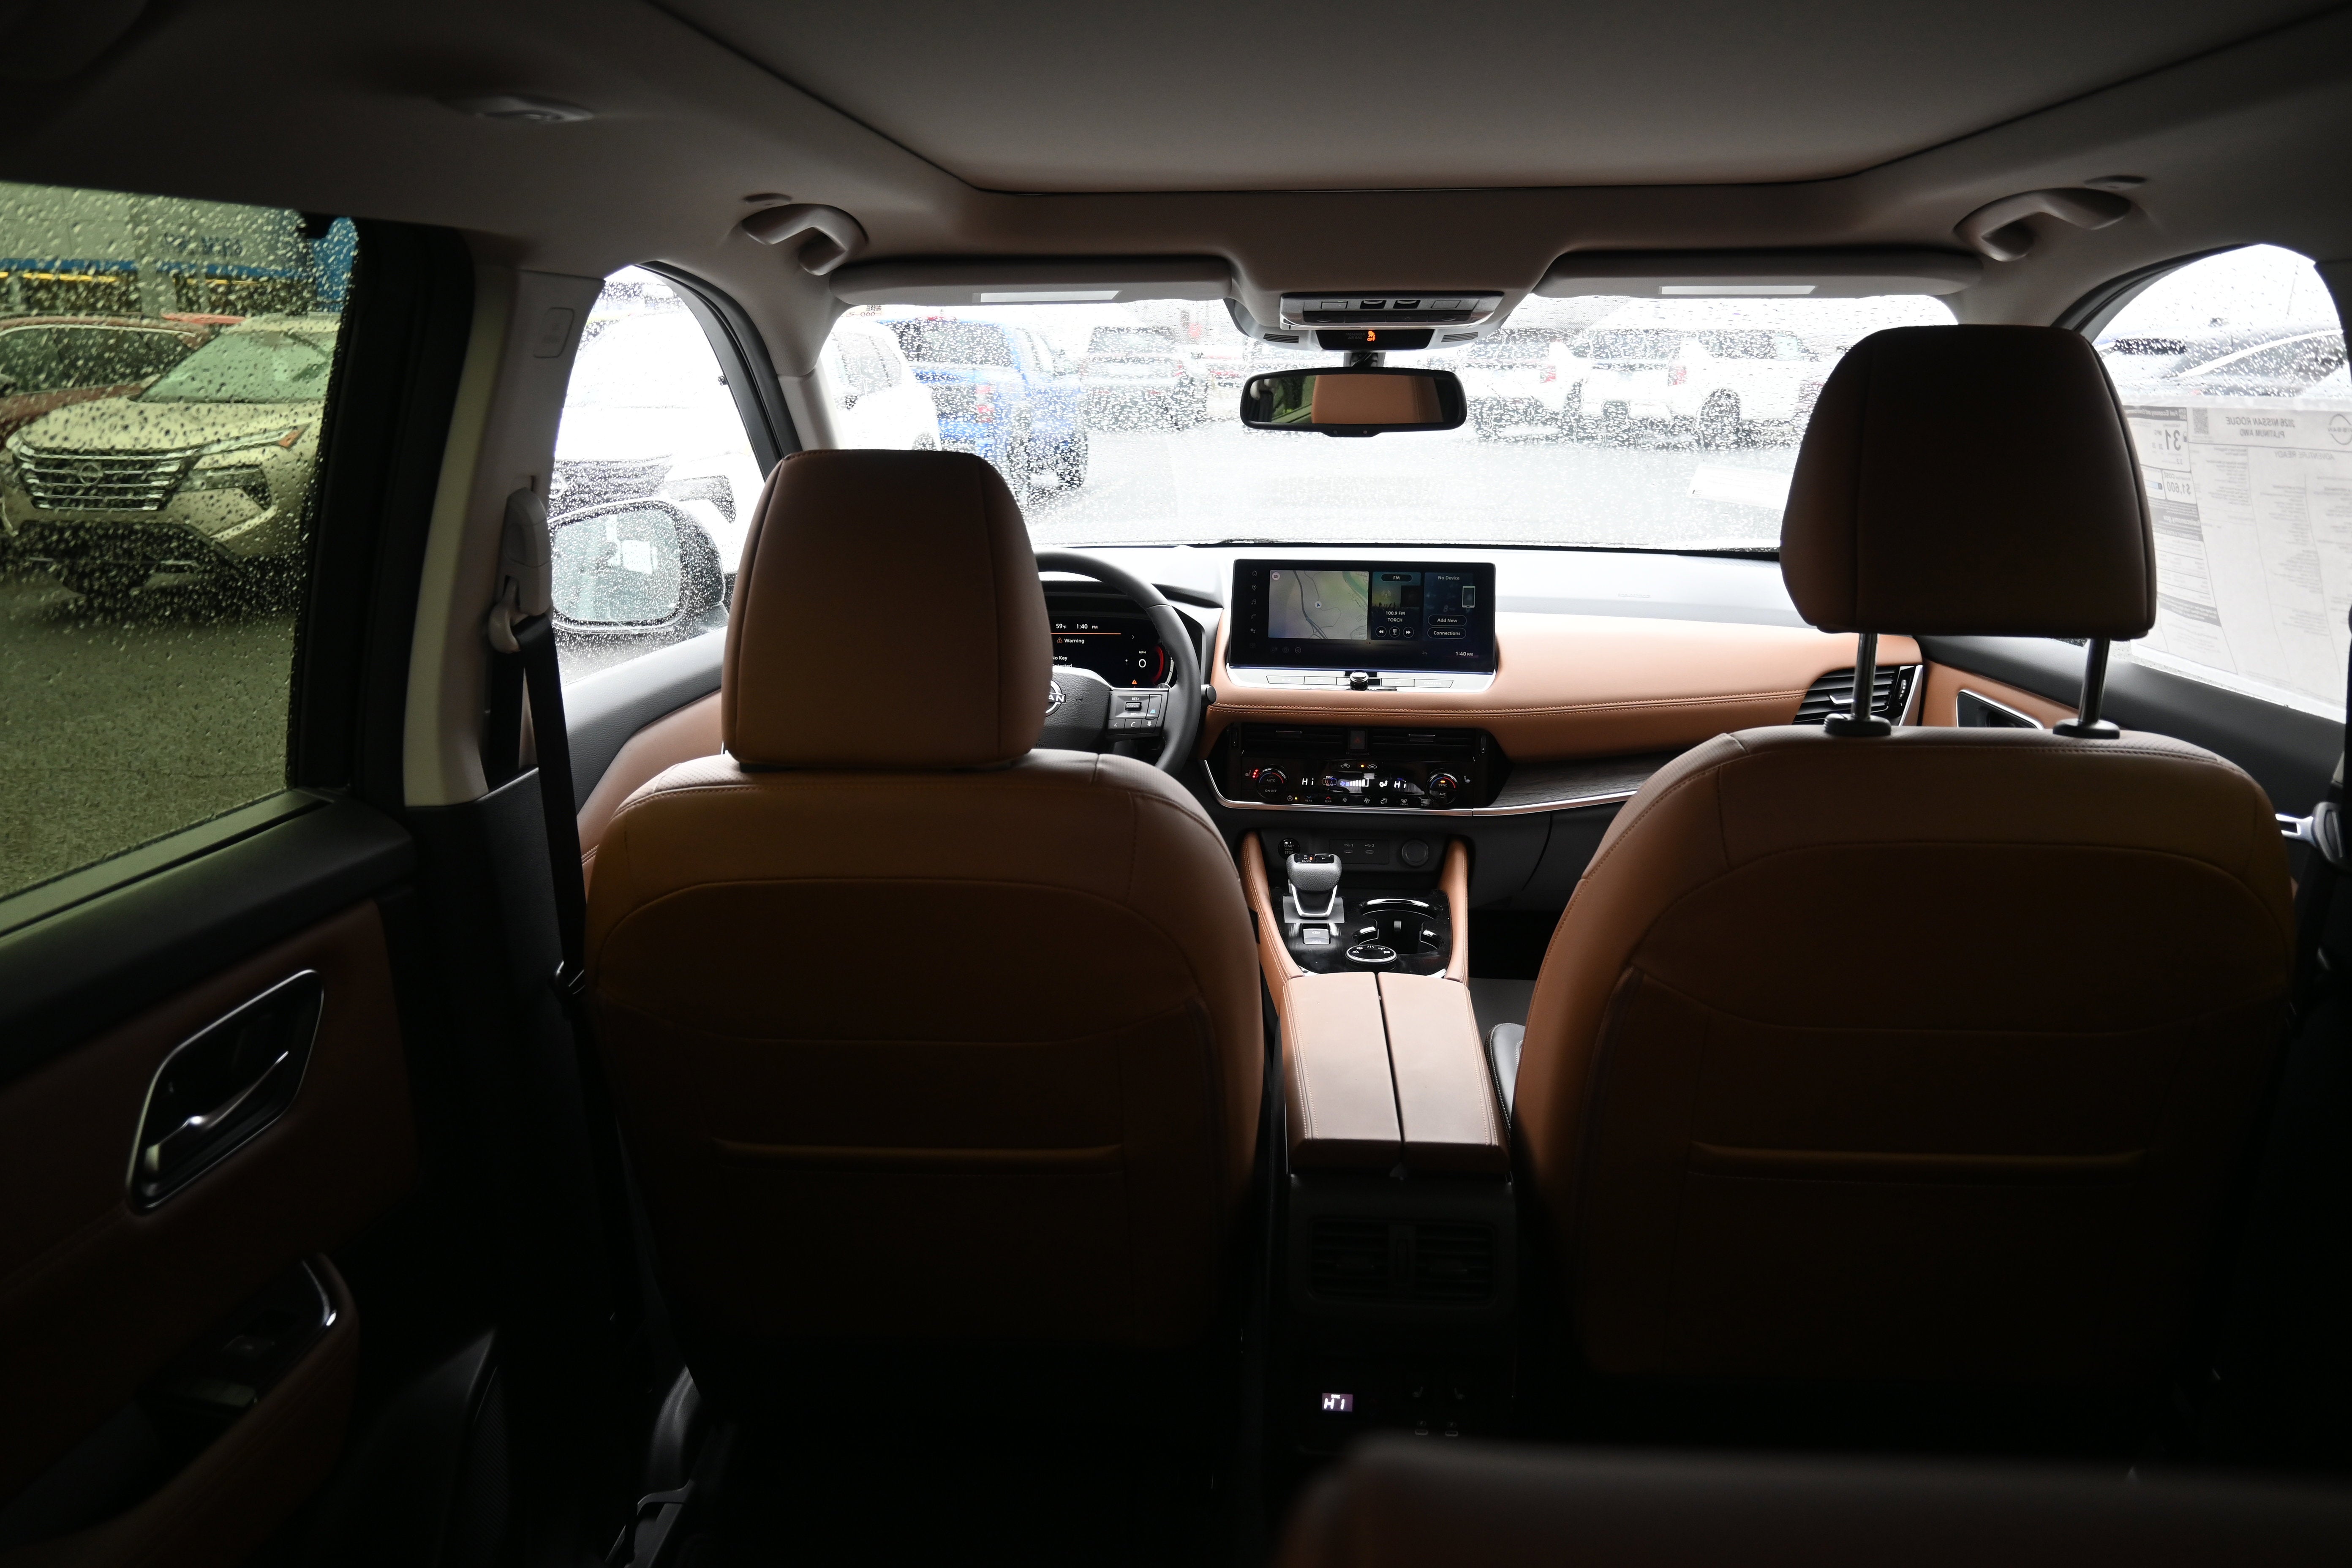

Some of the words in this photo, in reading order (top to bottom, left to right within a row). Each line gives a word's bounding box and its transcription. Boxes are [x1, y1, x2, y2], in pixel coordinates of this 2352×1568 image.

[1138, 658, 1147, 668] 0
[1302, 778, 1315, 786] Hi
[1394, 780, 1407, 789] Hi
